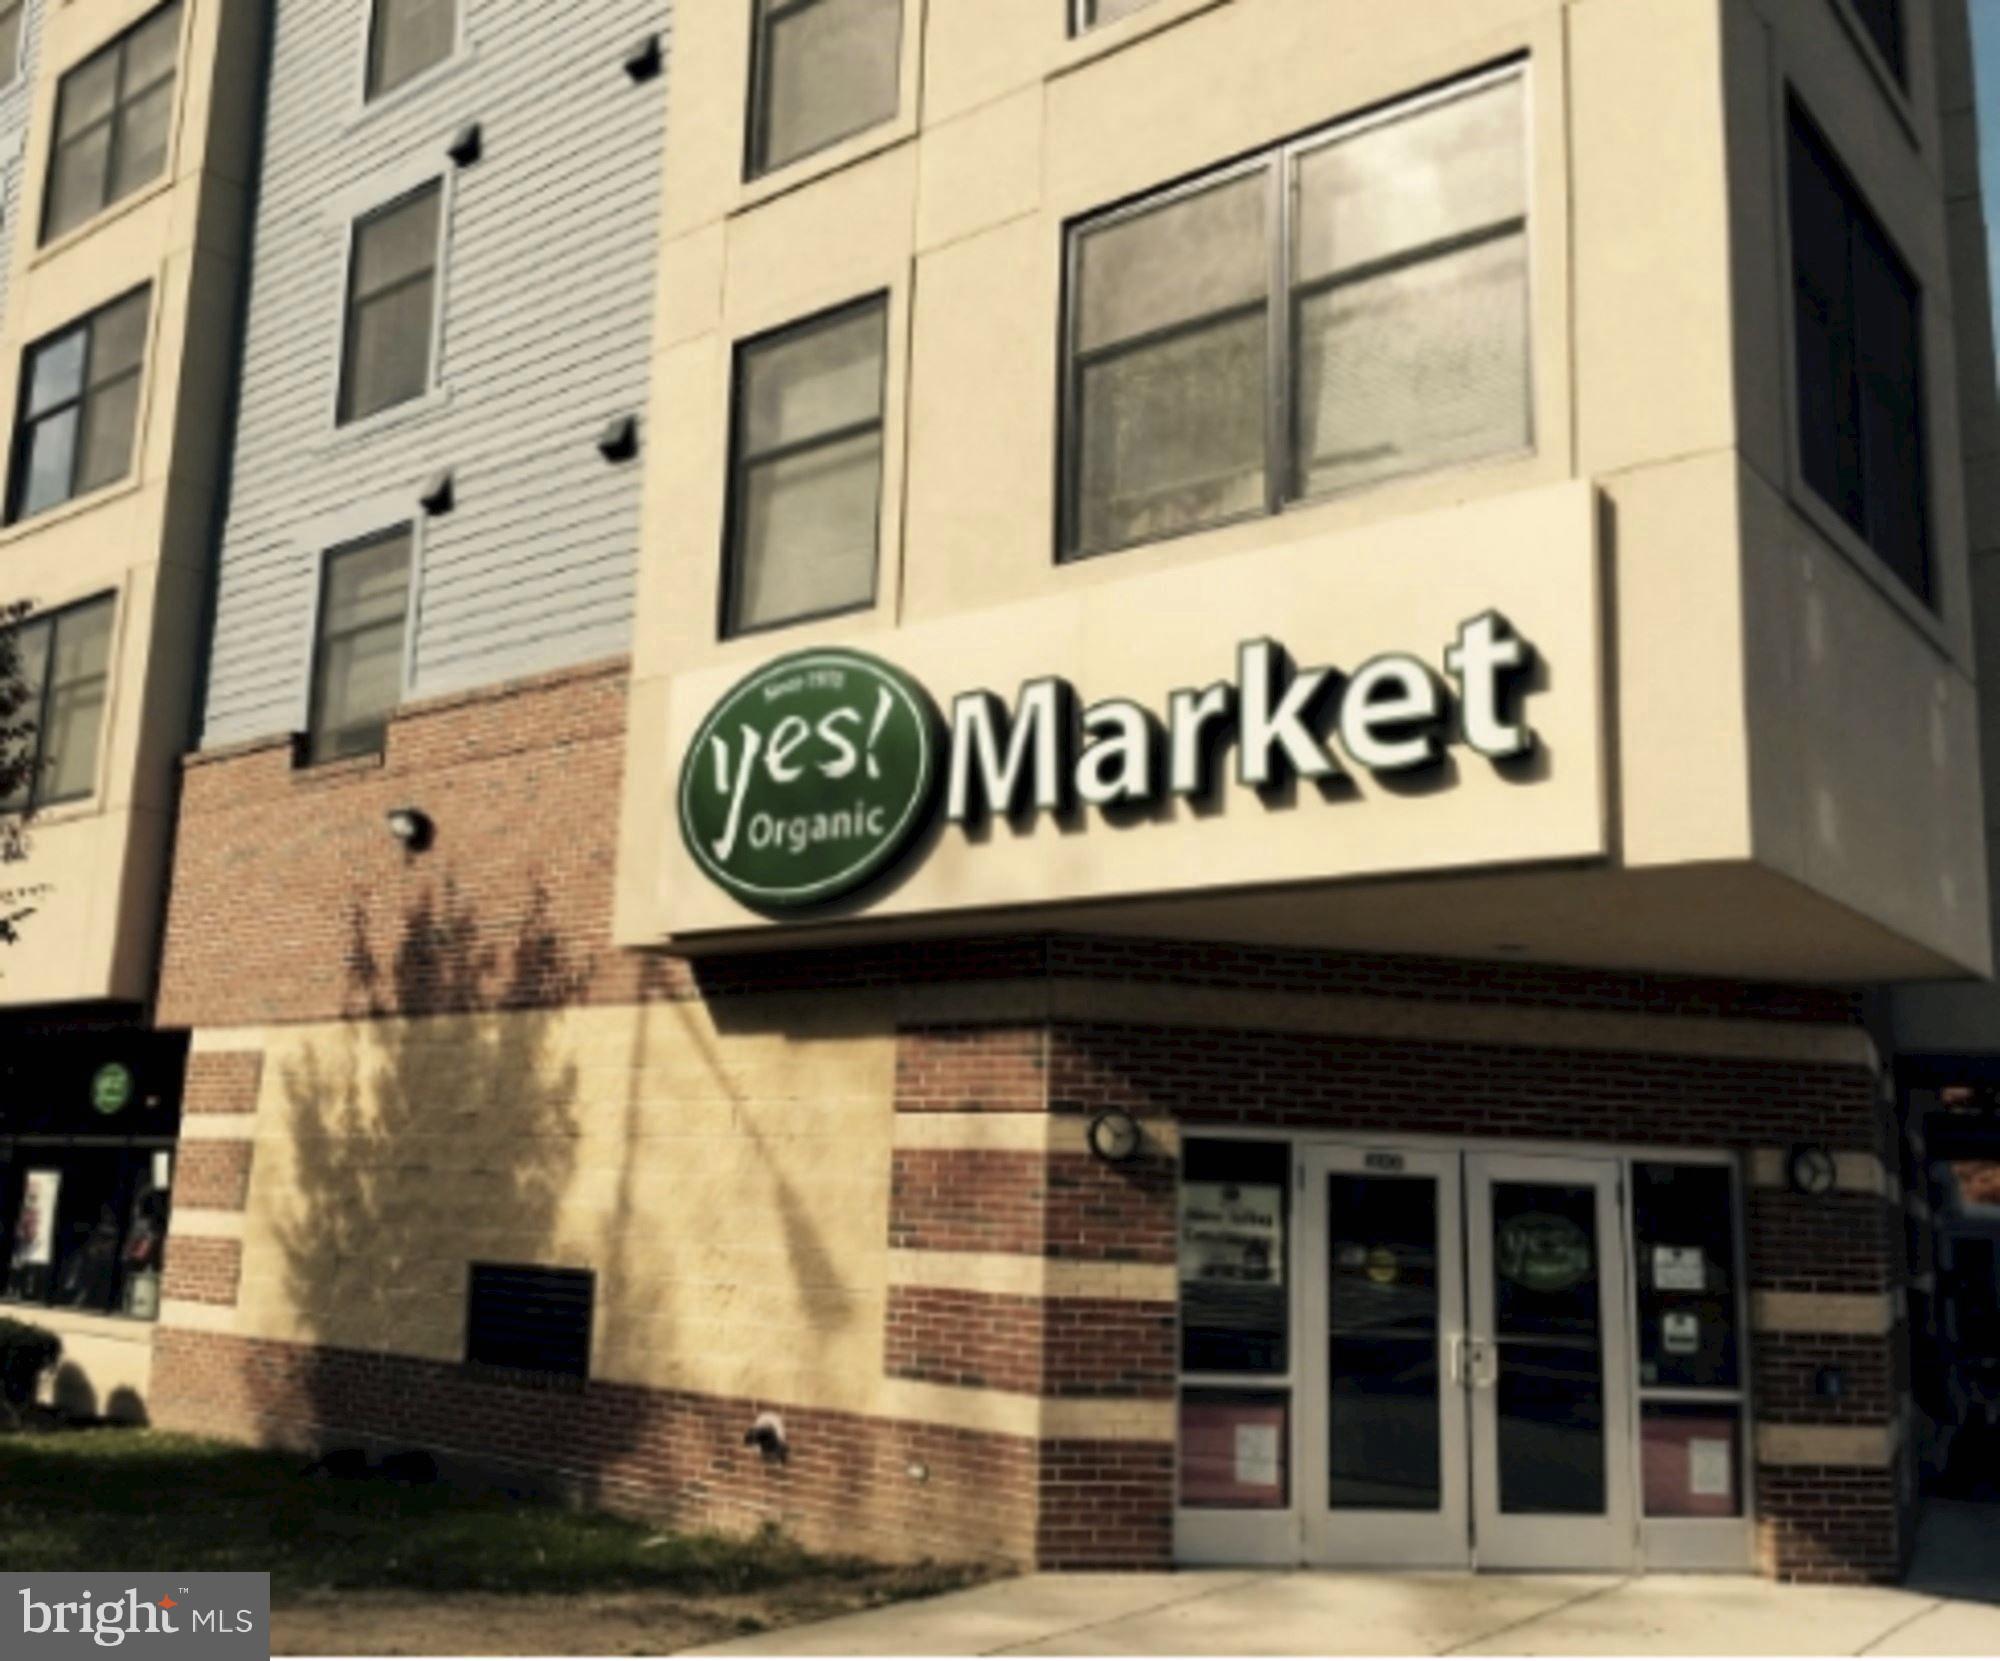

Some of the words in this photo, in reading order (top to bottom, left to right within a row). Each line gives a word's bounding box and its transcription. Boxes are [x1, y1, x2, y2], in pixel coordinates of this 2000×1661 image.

[710, 686, 893, 861] yes!
[946, 609, 1524, 821] Market
[748, 799, 884, 854] Organic
